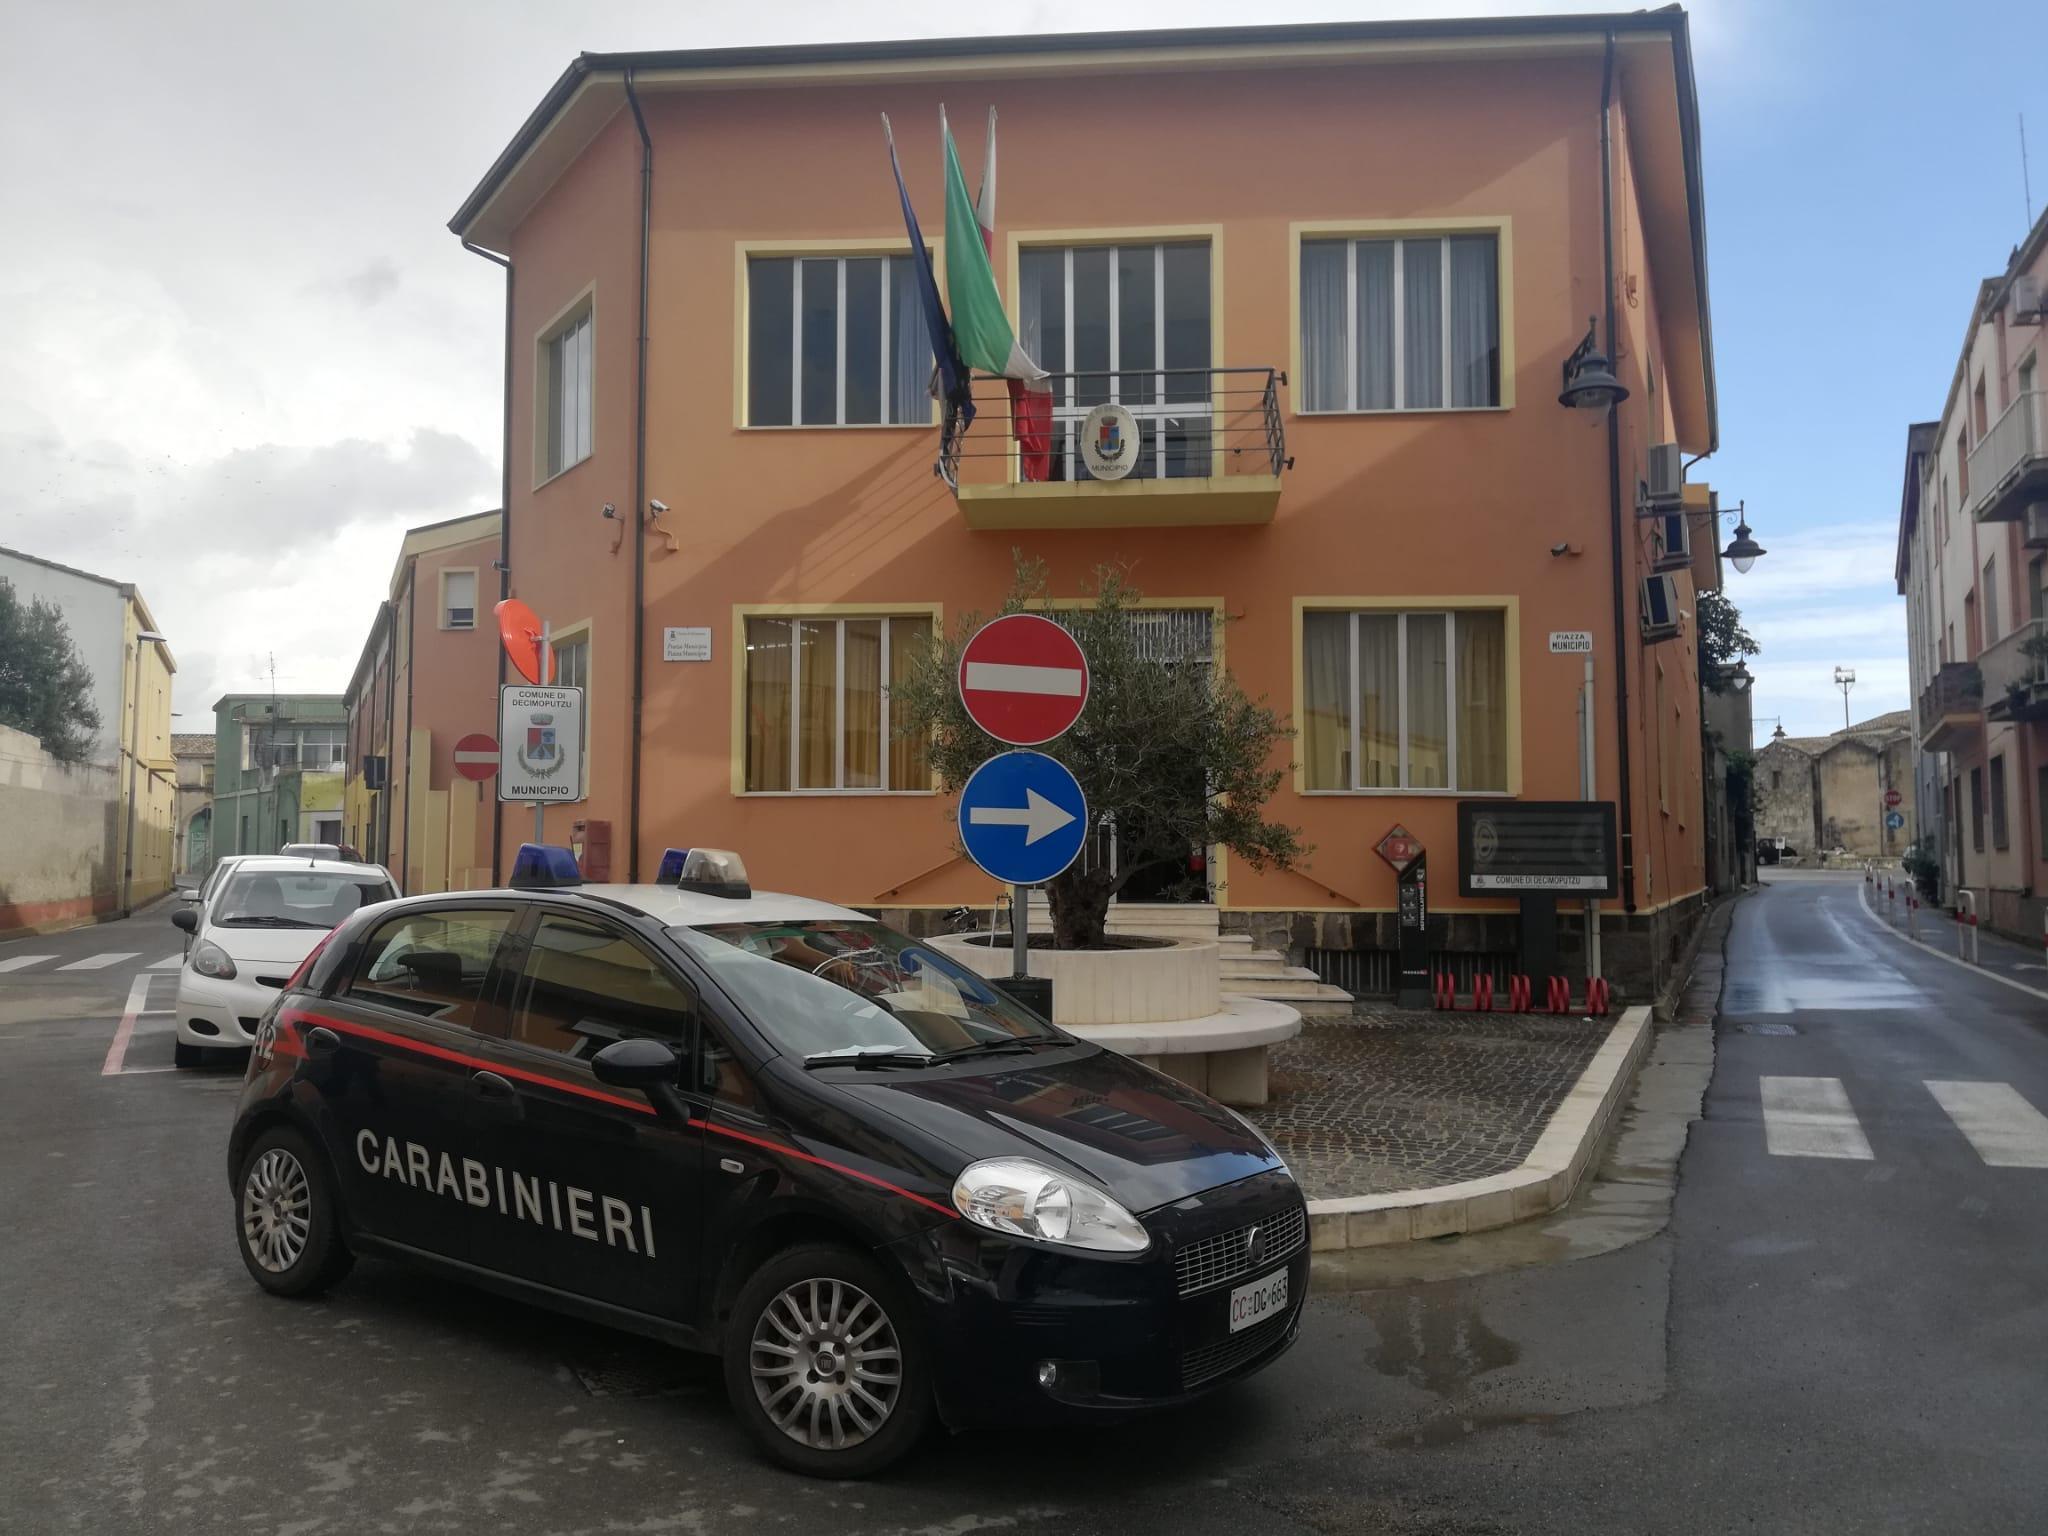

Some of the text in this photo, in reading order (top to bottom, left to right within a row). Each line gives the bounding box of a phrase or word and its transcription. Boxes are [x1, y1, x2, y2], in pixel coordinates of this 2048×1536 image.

[1092, 464, 1128, 472] MUNICIPIO
[1552, 641, 1590, 650] MUNICIPIO
[519, 690, 555, 699] COMUNE
[512, 699, 572, 708] DECIMOPUTZU
[511, 785, 569, 795] MUNICIPIO
[1495, 876, 1523, 885] COMUNE
[1533, 877, 1581, 885] DECIMOPUTZU
[356, 1128, 656, 1258] CARABINIERI
